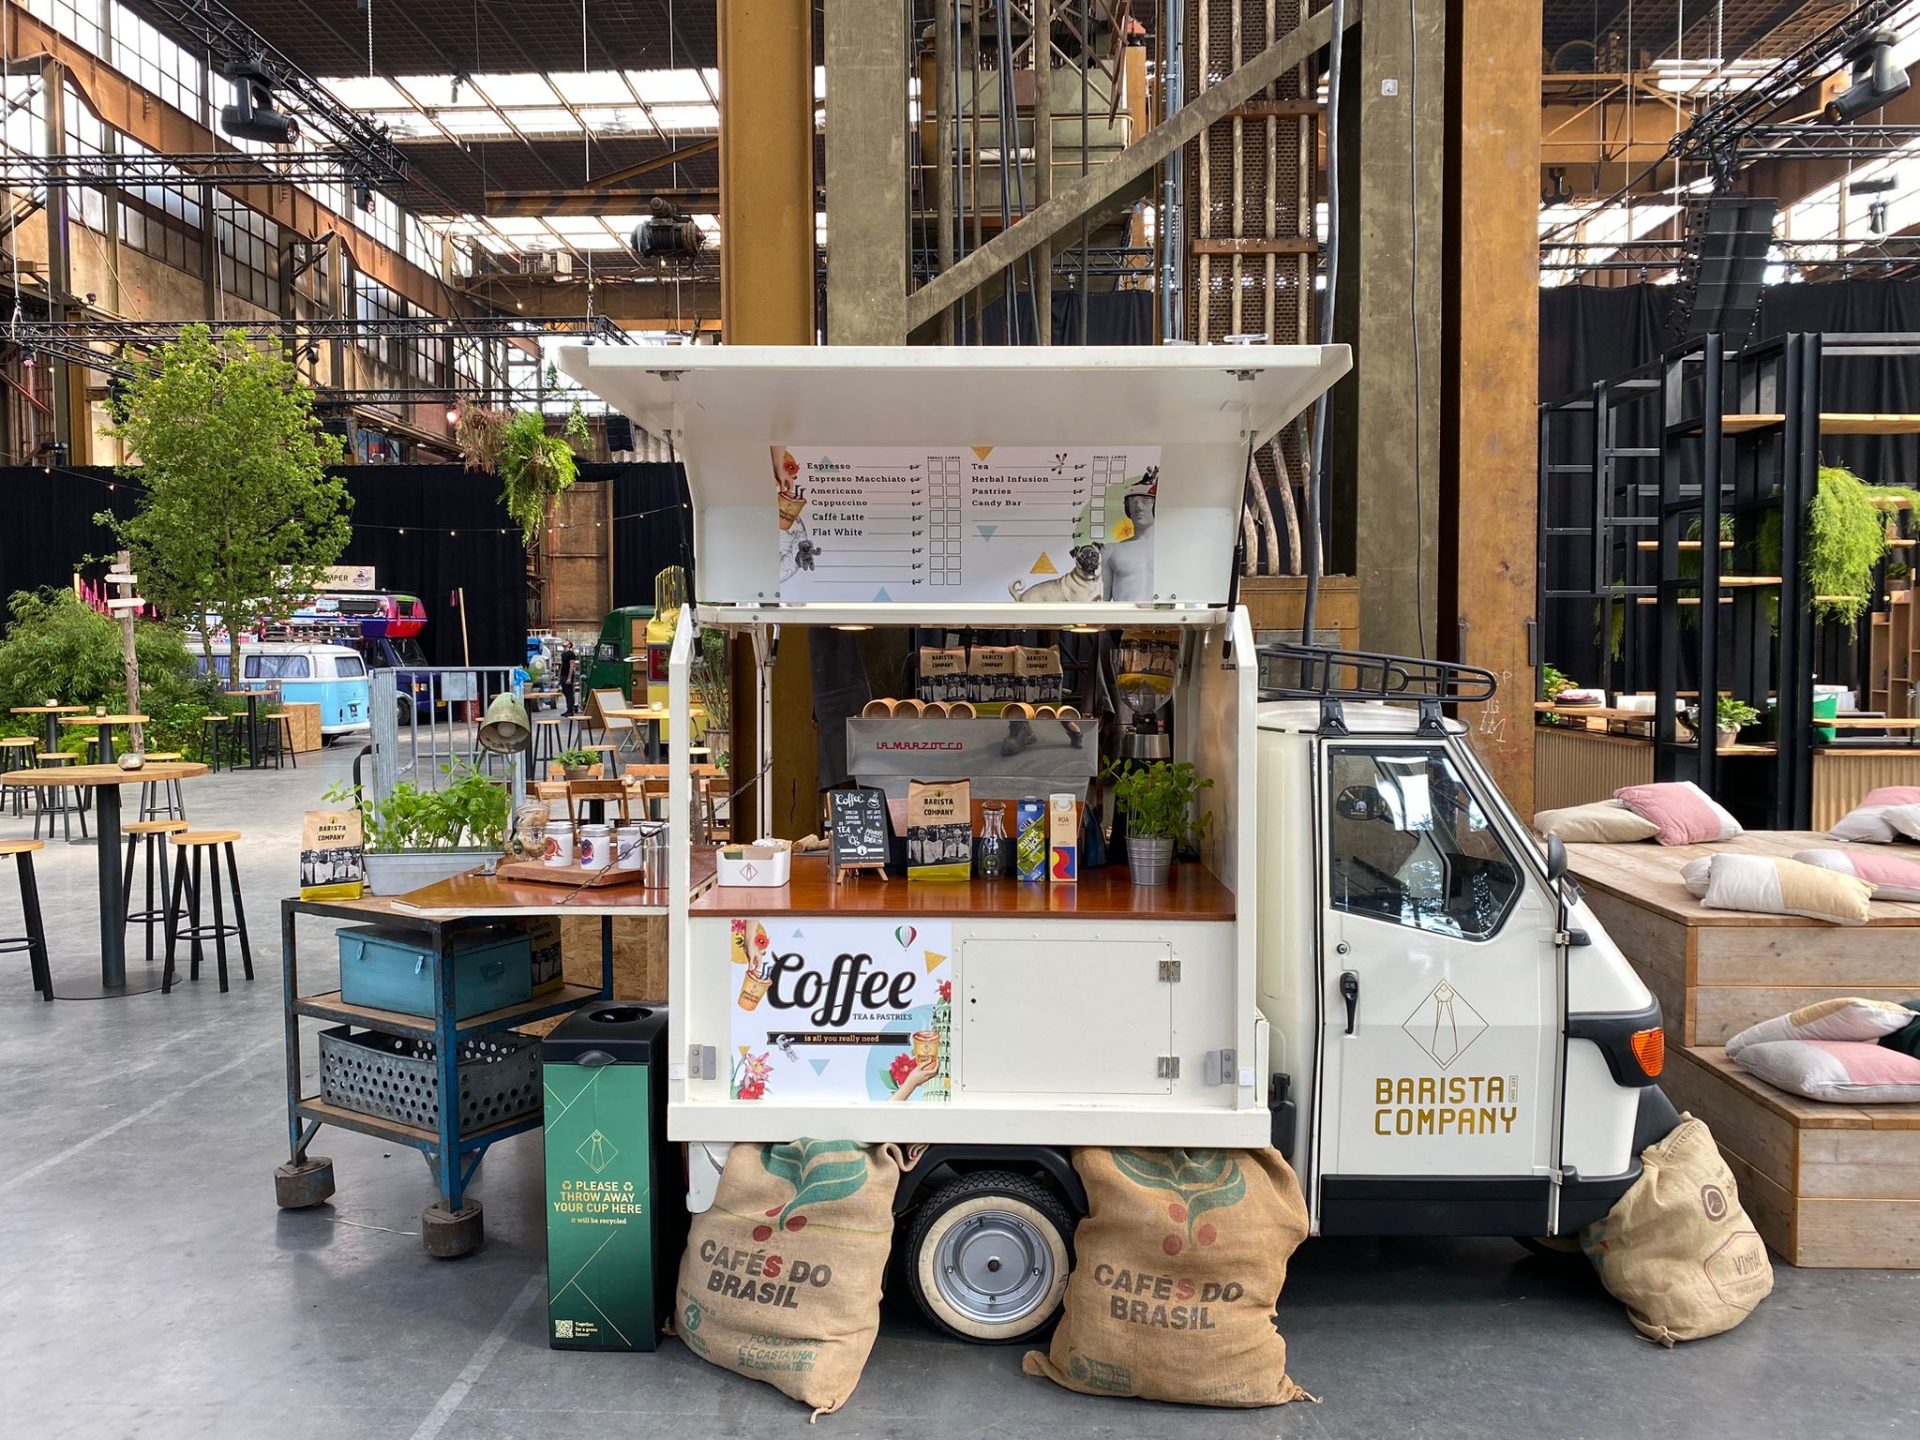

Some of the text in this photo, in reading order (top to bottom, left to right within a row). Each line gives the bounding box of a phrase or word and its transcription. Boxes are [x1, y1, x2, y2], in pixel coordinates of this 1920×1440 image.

[807, 462, 851, 471] Espresso
[808, 475, 906, 483] Espresso Macchiato
[971, 475, 1049, 483] Herbal Infusion
[971, 500, 1002, 508] Candy
[812, 513, 865, 521] Caffè Latte
[812, 528, 863, 536] Flat White
[893, 742, 963, 750] MARZOCCO
[836, 792, 864, 808] Coffee
[837, 826, 851, 834] TEA
[767, 951, 916, 1027] Coffee
[853, 1013, 913, 1021] TEA & PASTRIES
[804, 1034, 879, 1043] is all you really need
[1375, 1076, 1505, 1105] BARISTA
[1374, 1106, 1518, 1136] COMPANY
[575, 1181, 619, 1191] PLEASE
[560, 1191, 635, 1203] THROW AWAY
[553, 1202, 642, 1214] YOUR CUP HERE
[700, 1239, 832, 1288] CAFÉS DO
[1094, 1263, 1244, 1303] CAFÉS DO
[706, 1269, 799, 1310] BRASIL
[1110, 1295, 1216, 1331] BRASIL
[749, 1333, 781, 1346] FOOD
